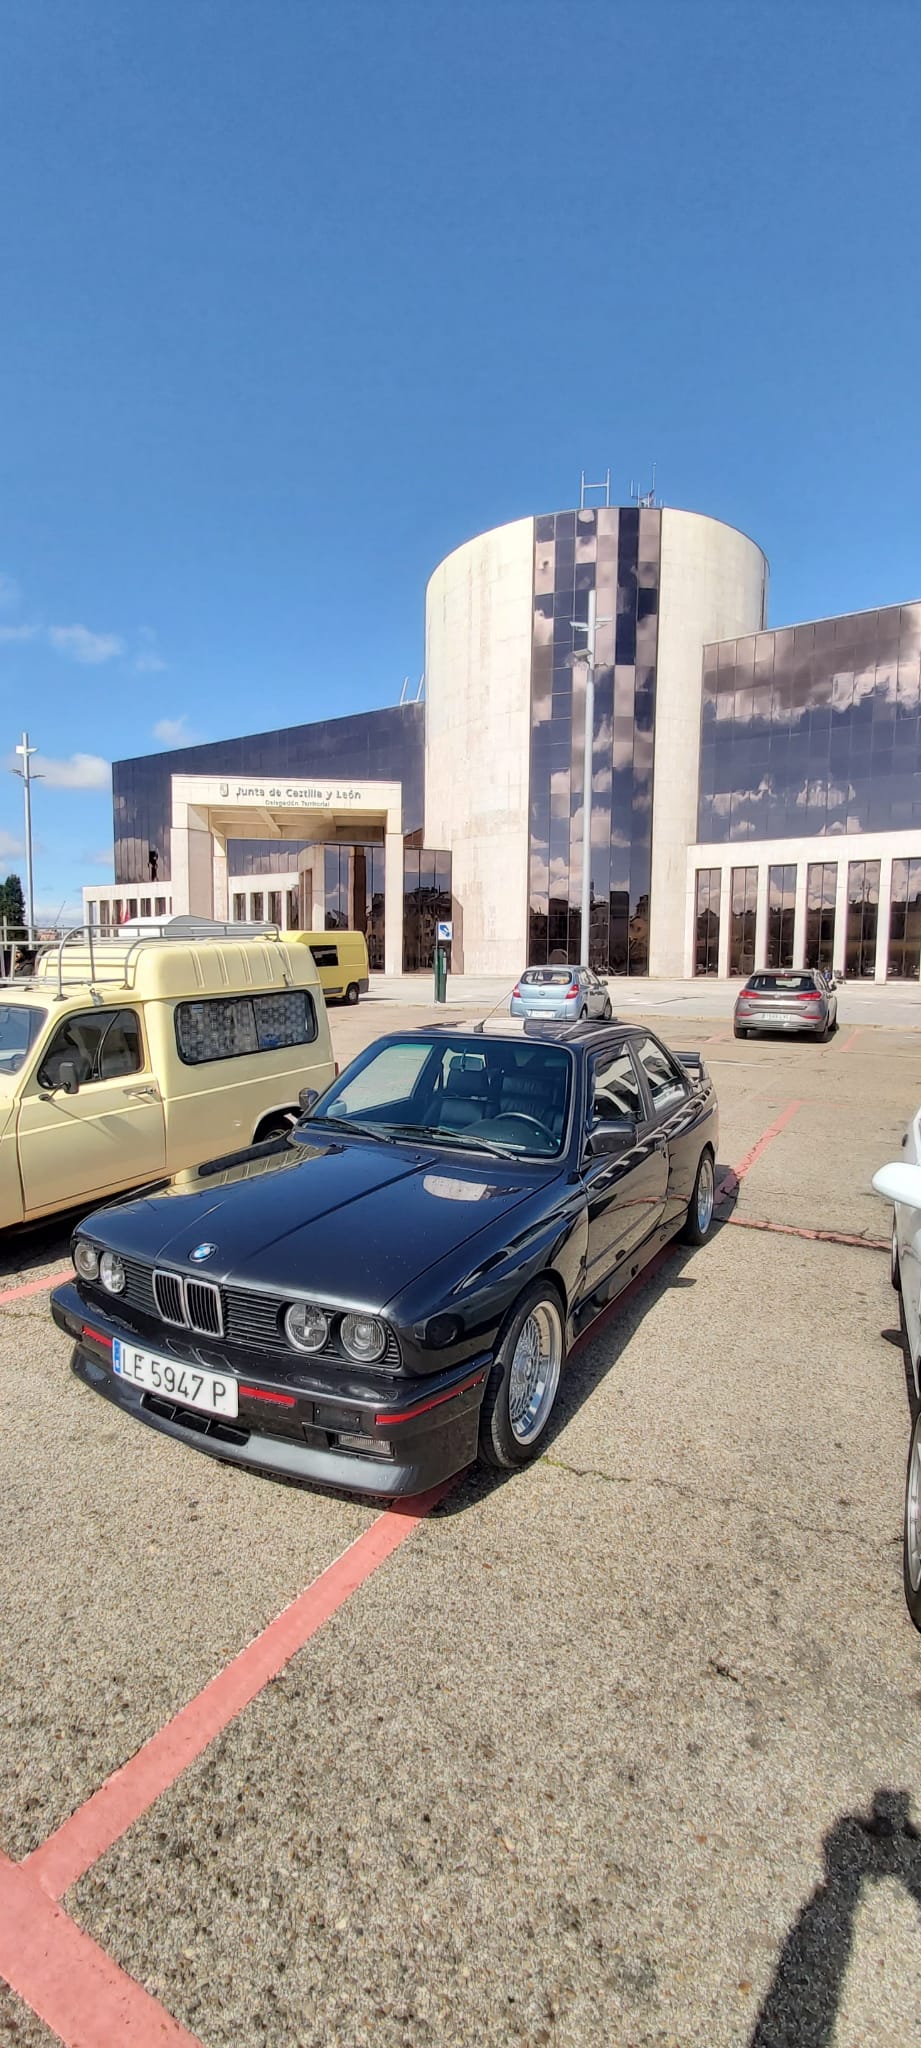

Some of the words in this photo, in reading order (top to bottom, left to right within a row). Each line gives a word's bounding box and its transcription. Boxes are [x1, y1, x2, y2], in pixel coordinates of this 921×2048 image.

[236, 786, 265, 798] Junta
[269, 787, 282, 797] de
[286, 788, 323, 798] Castilla
[325, 791, 333, 801] y
[336, 789, 361, 799] León
[122, 1348, 145, 1382] LE
[151, 1360, 204, 1402] 5947
[212, 1380, 226, 1407] P
